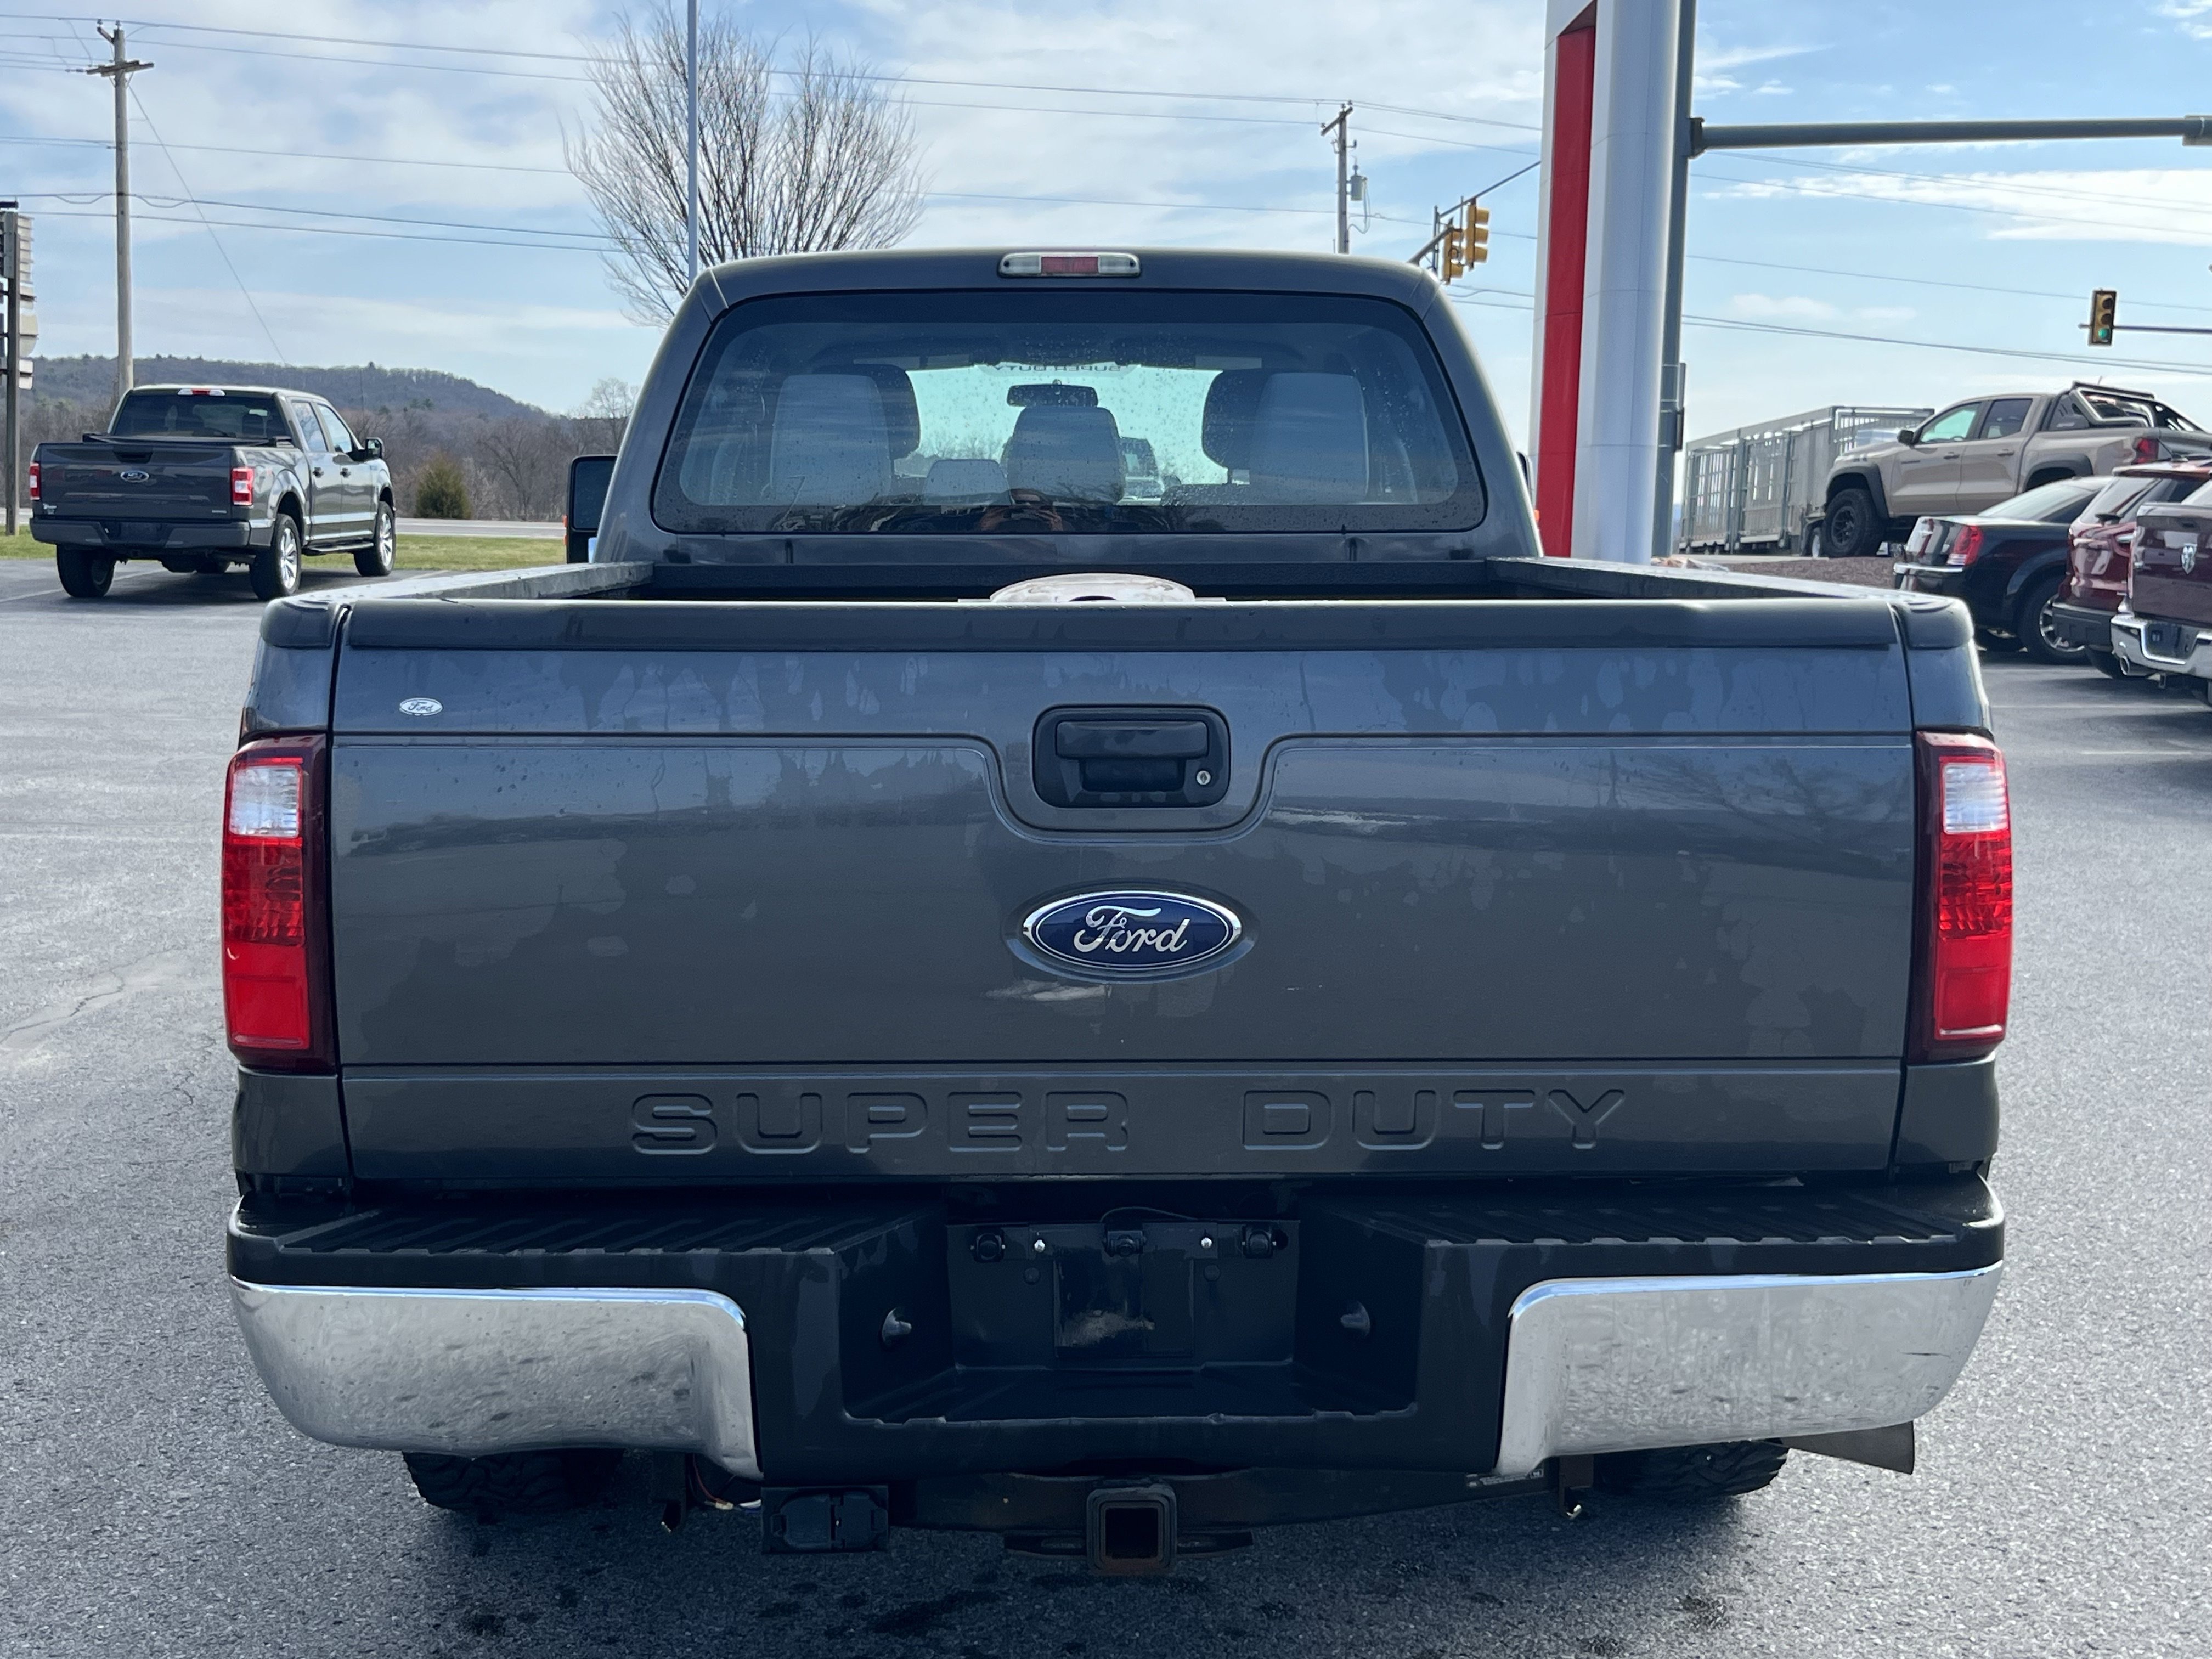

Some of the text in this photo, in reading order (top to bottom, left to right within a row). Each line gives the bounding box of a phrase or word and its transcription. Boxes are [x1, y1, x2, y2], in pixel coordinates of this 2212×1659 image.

[408, 701, 434, 712] Ford
[1073, 905, 1191, 952] Ford
[631, 1089, 1624, 1155] SUPER DUTY
